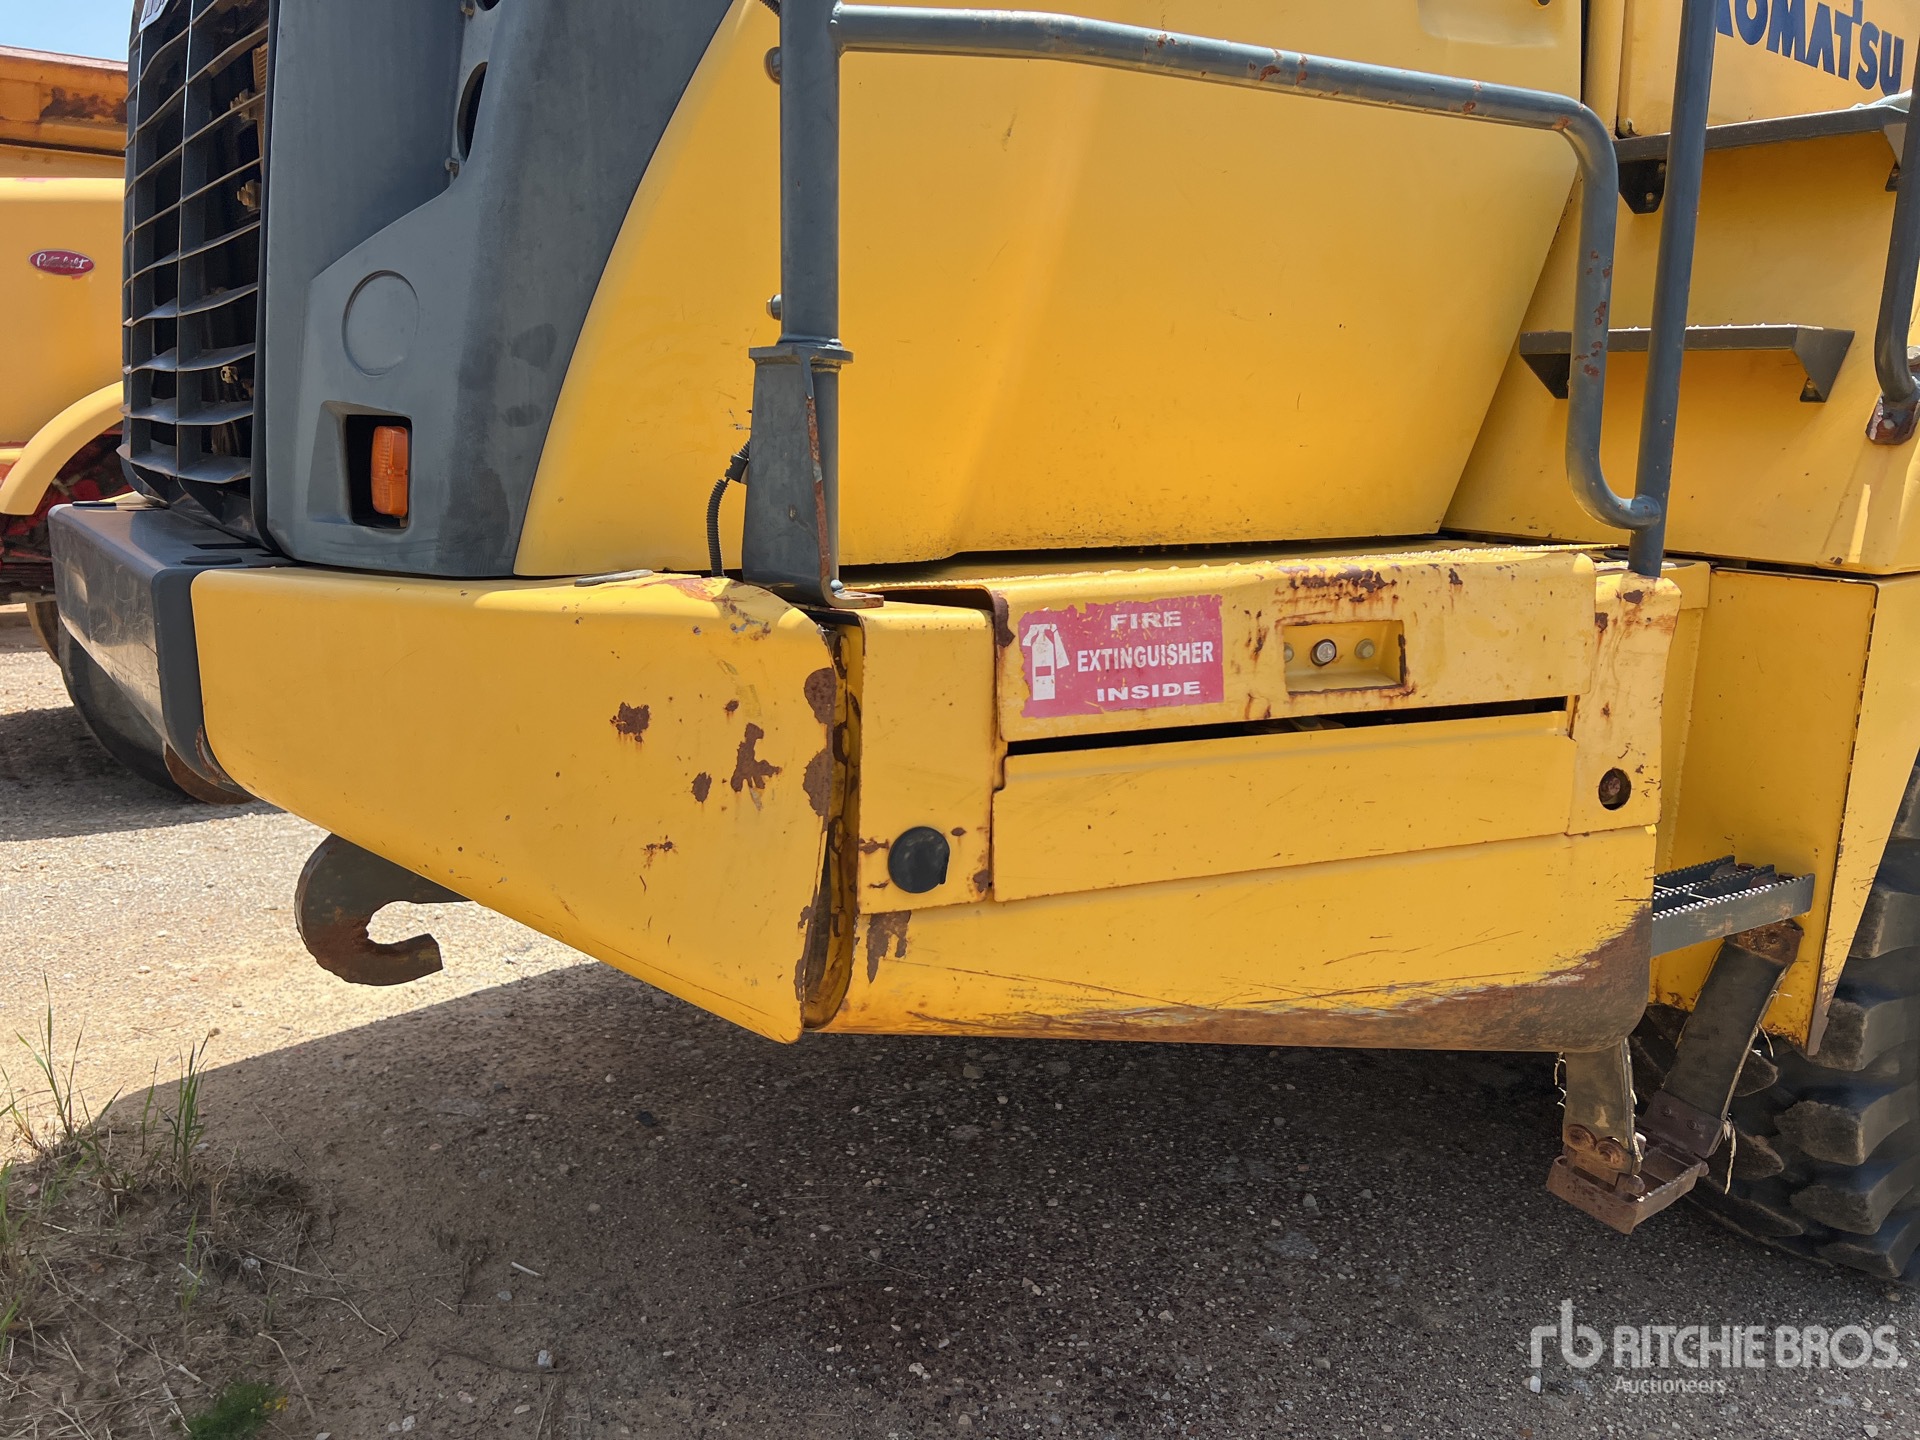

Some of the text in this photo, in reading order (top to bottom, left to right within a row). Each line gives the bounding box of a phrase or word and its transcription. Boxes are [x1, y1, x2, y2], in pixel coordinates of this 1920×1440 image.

[1715, 0, 1904, 96] OMATSU
[1110, 611, 1182, 631] FIRE
[1077, 641, 1214, 673] EXTINGUISHER
[1096, 682, 1200, 702] INSIDE
